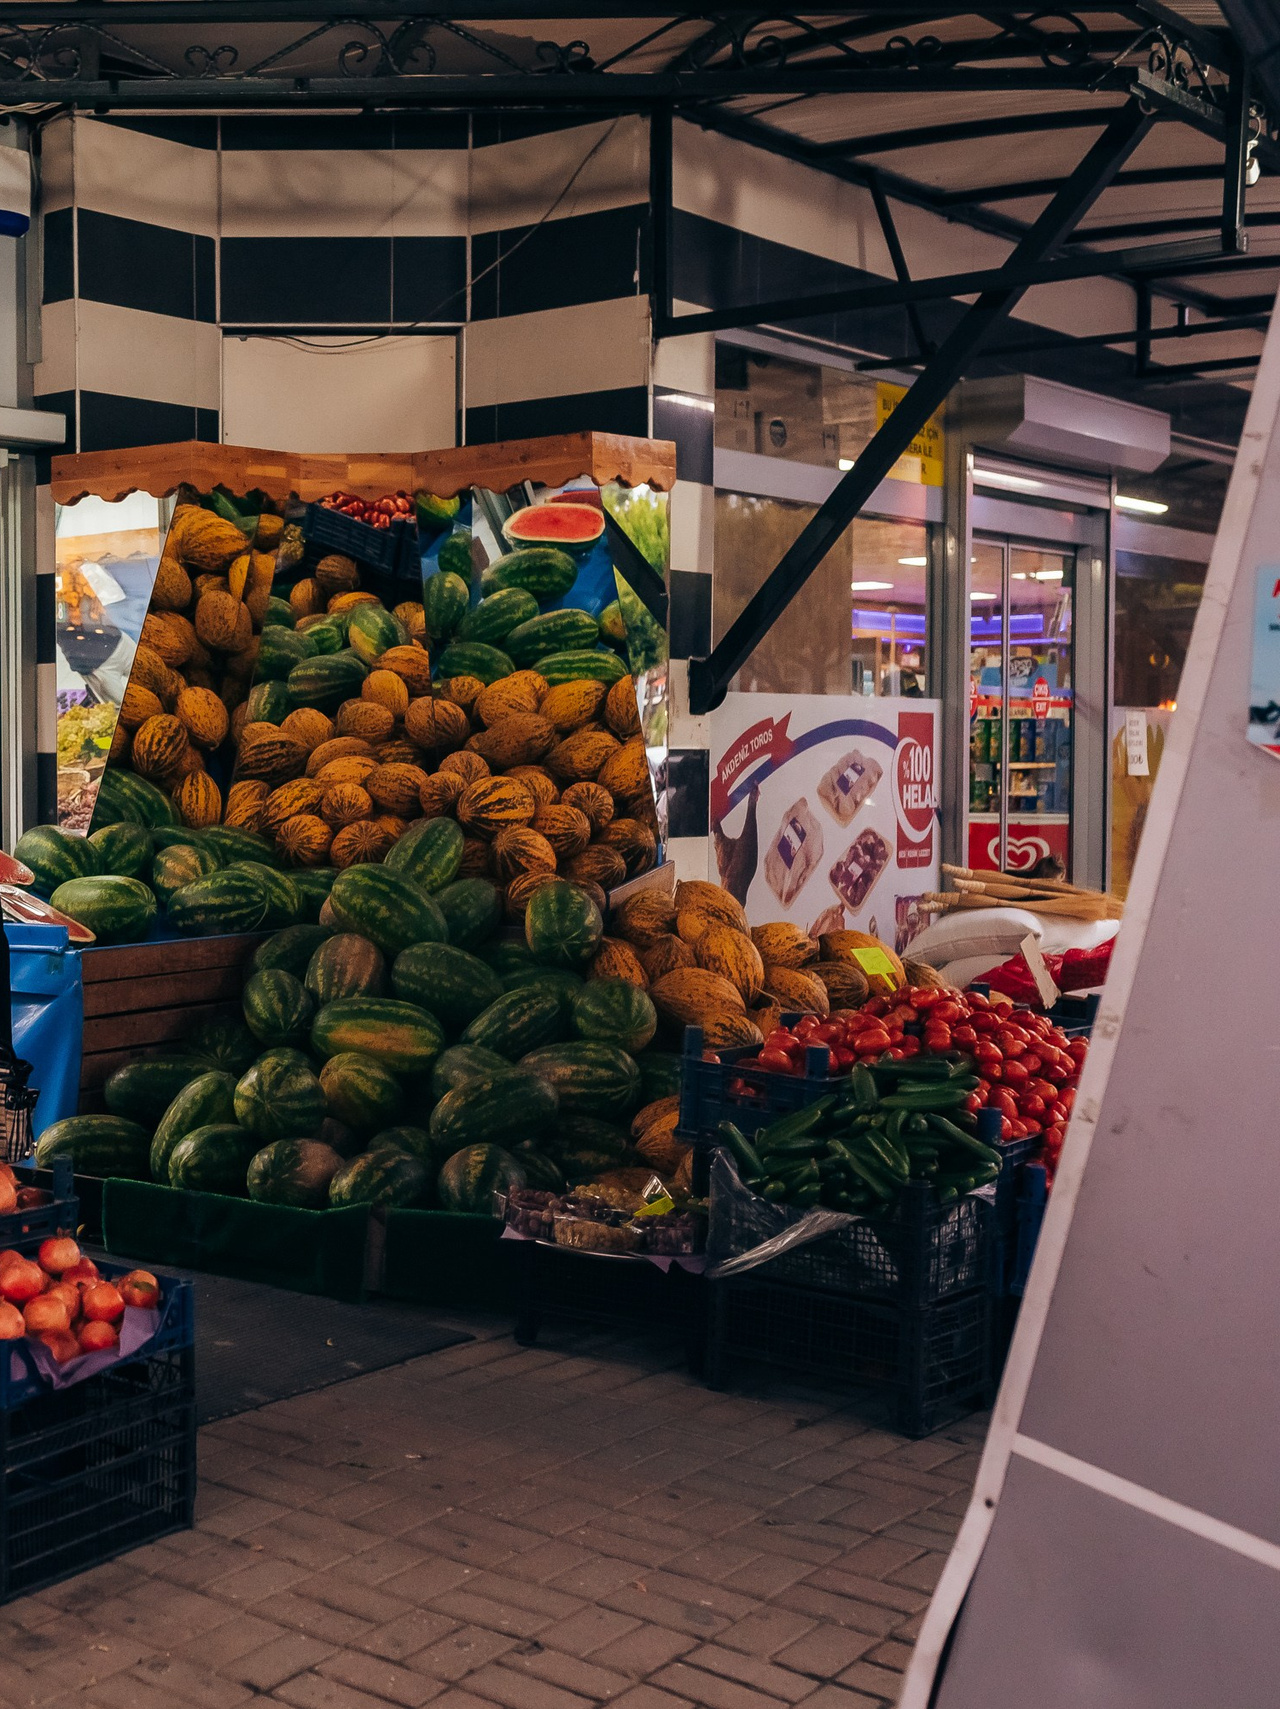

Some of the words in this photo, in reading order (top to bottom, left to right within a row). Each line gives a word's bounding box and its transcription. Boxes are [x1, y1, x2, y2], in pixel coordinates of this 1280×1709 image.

[721, 744, 750, 784] AKDENİZ
[749, 728, 773, 753] TOROS
[902, 745, 931, 783] %100
